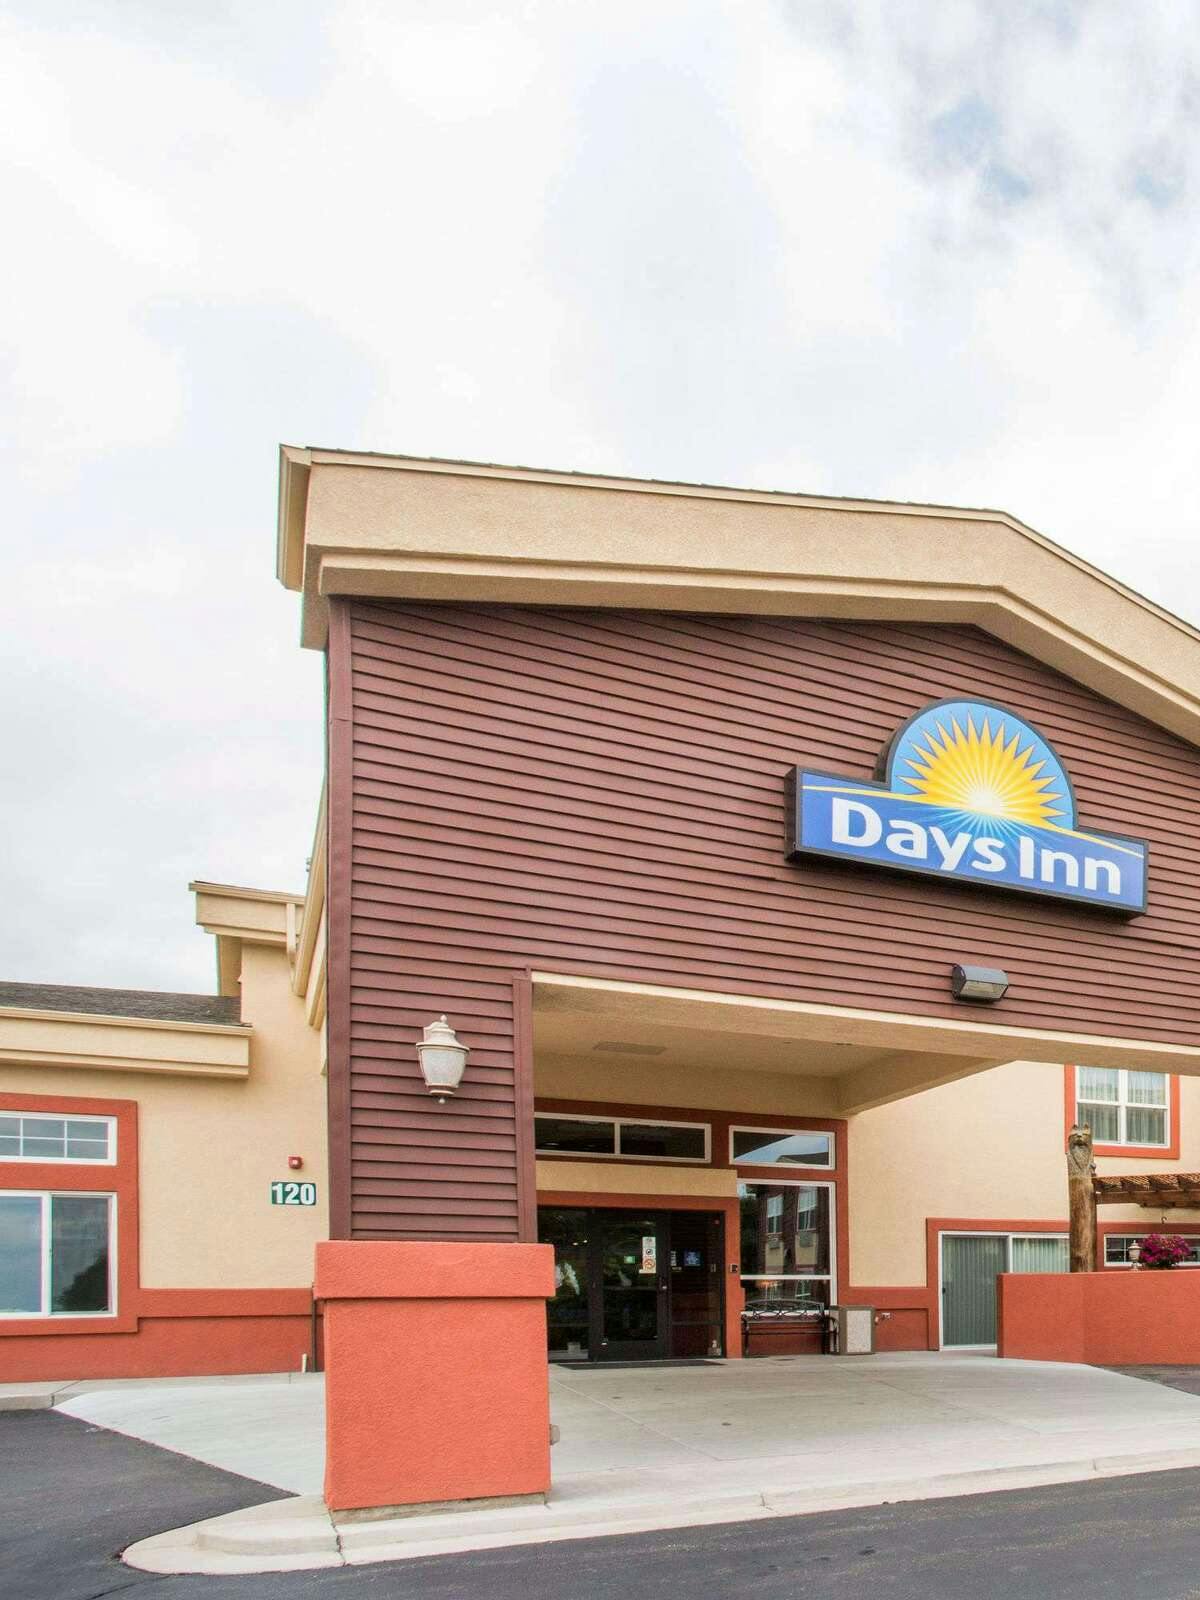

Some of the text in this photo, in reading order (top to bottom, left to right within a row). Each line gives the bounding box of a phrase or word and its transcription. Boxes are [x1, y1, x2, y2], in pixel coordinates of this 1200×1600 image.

[831, 797, 1121, 895] Days Inn
[272, 1183, 315, 1205] 120
